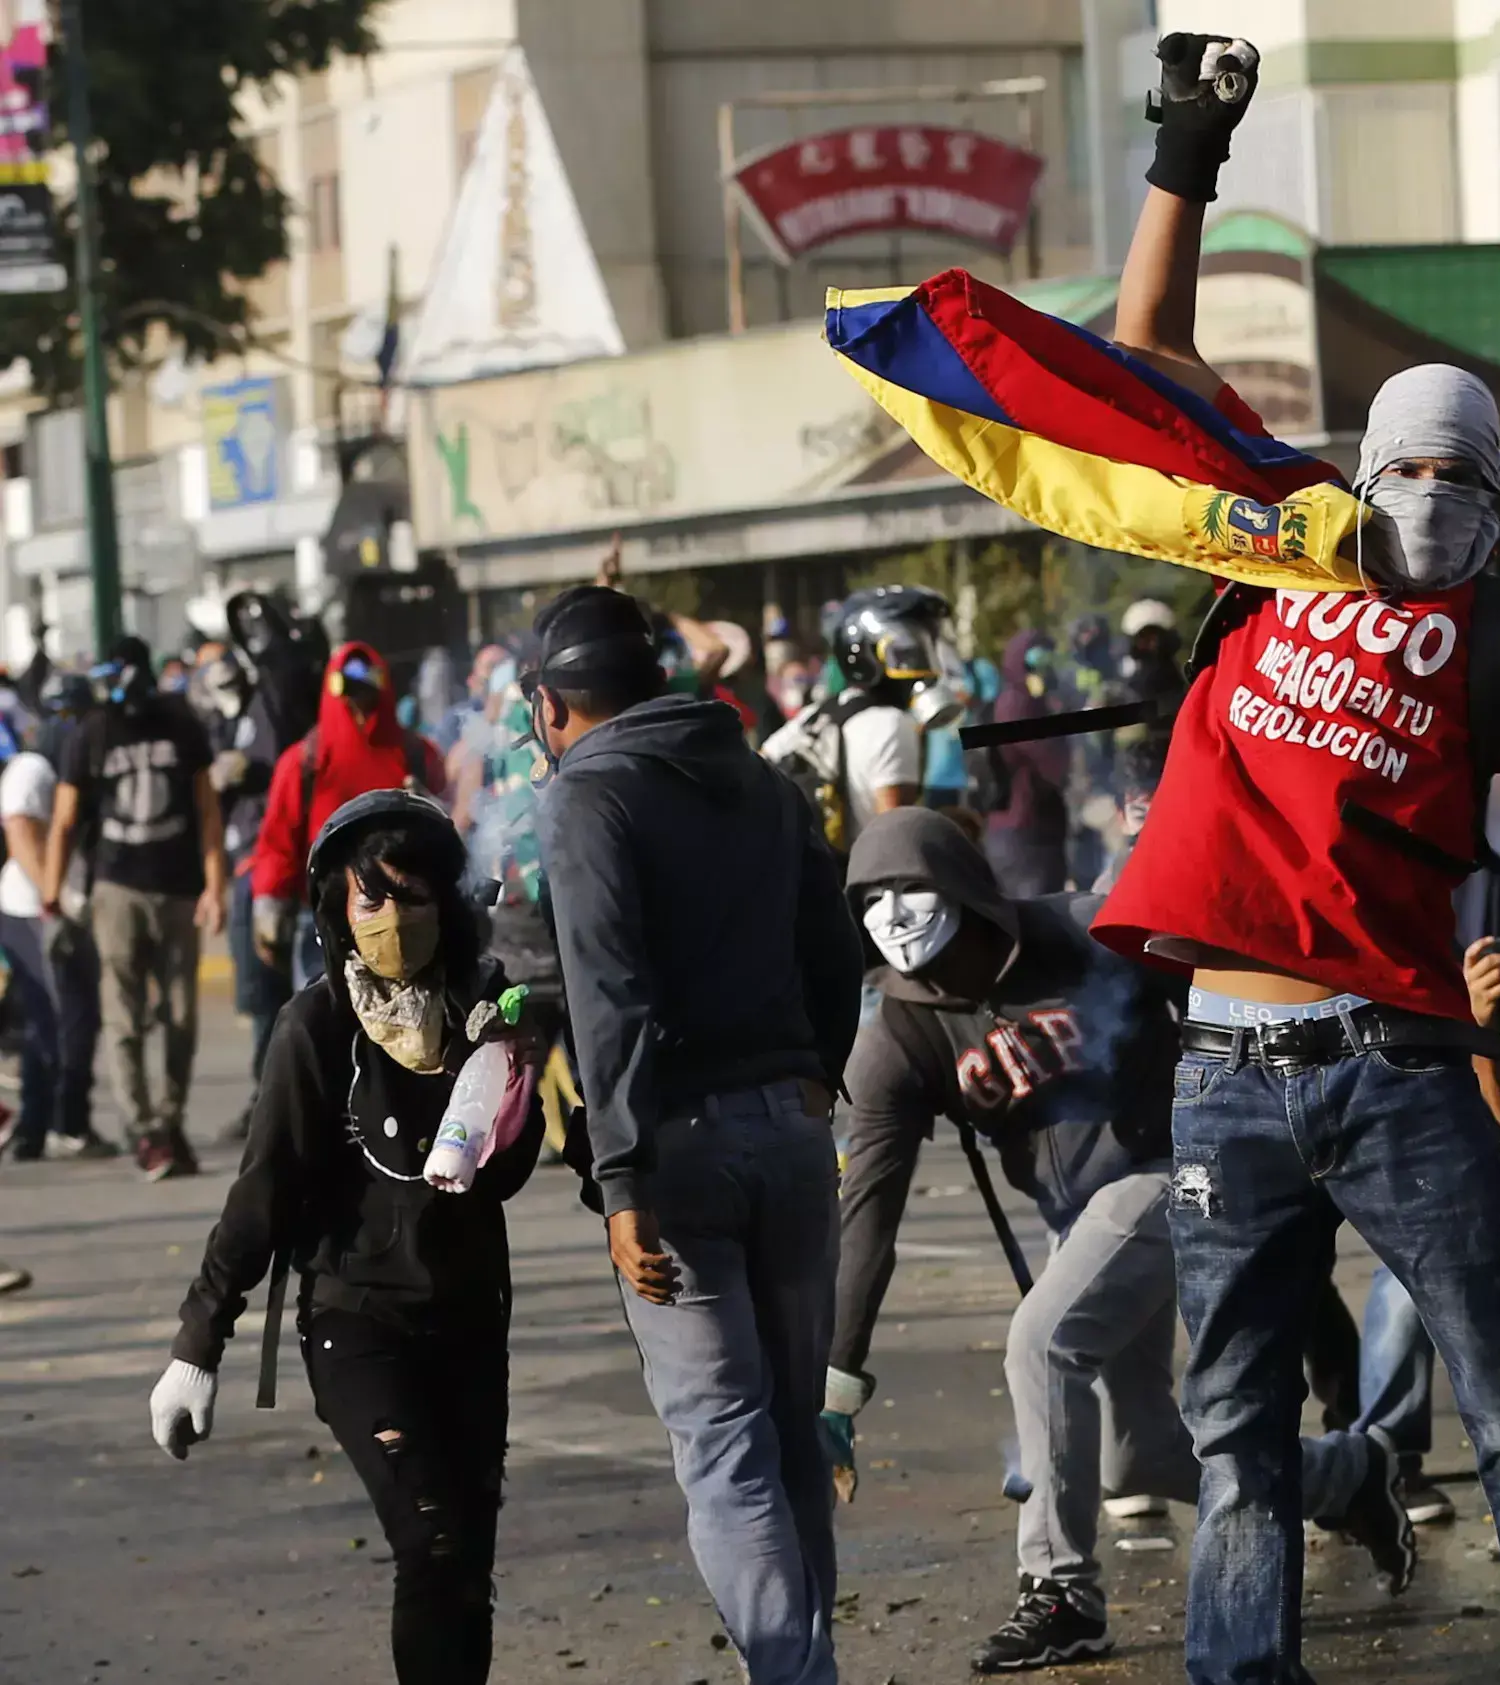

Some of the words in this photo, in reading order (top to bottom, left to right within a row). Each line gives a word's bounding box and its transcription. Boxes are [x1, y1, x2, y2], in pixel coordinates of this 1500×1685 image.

[1276, 589, 1457, 677] HUGO
[1275, 641, 1356, 714] AGO
[1345, 677, 1394, 720] EN
[1393, 693, 1434, 737] TU
[1229, 1002, 1273, 1021] LEO
